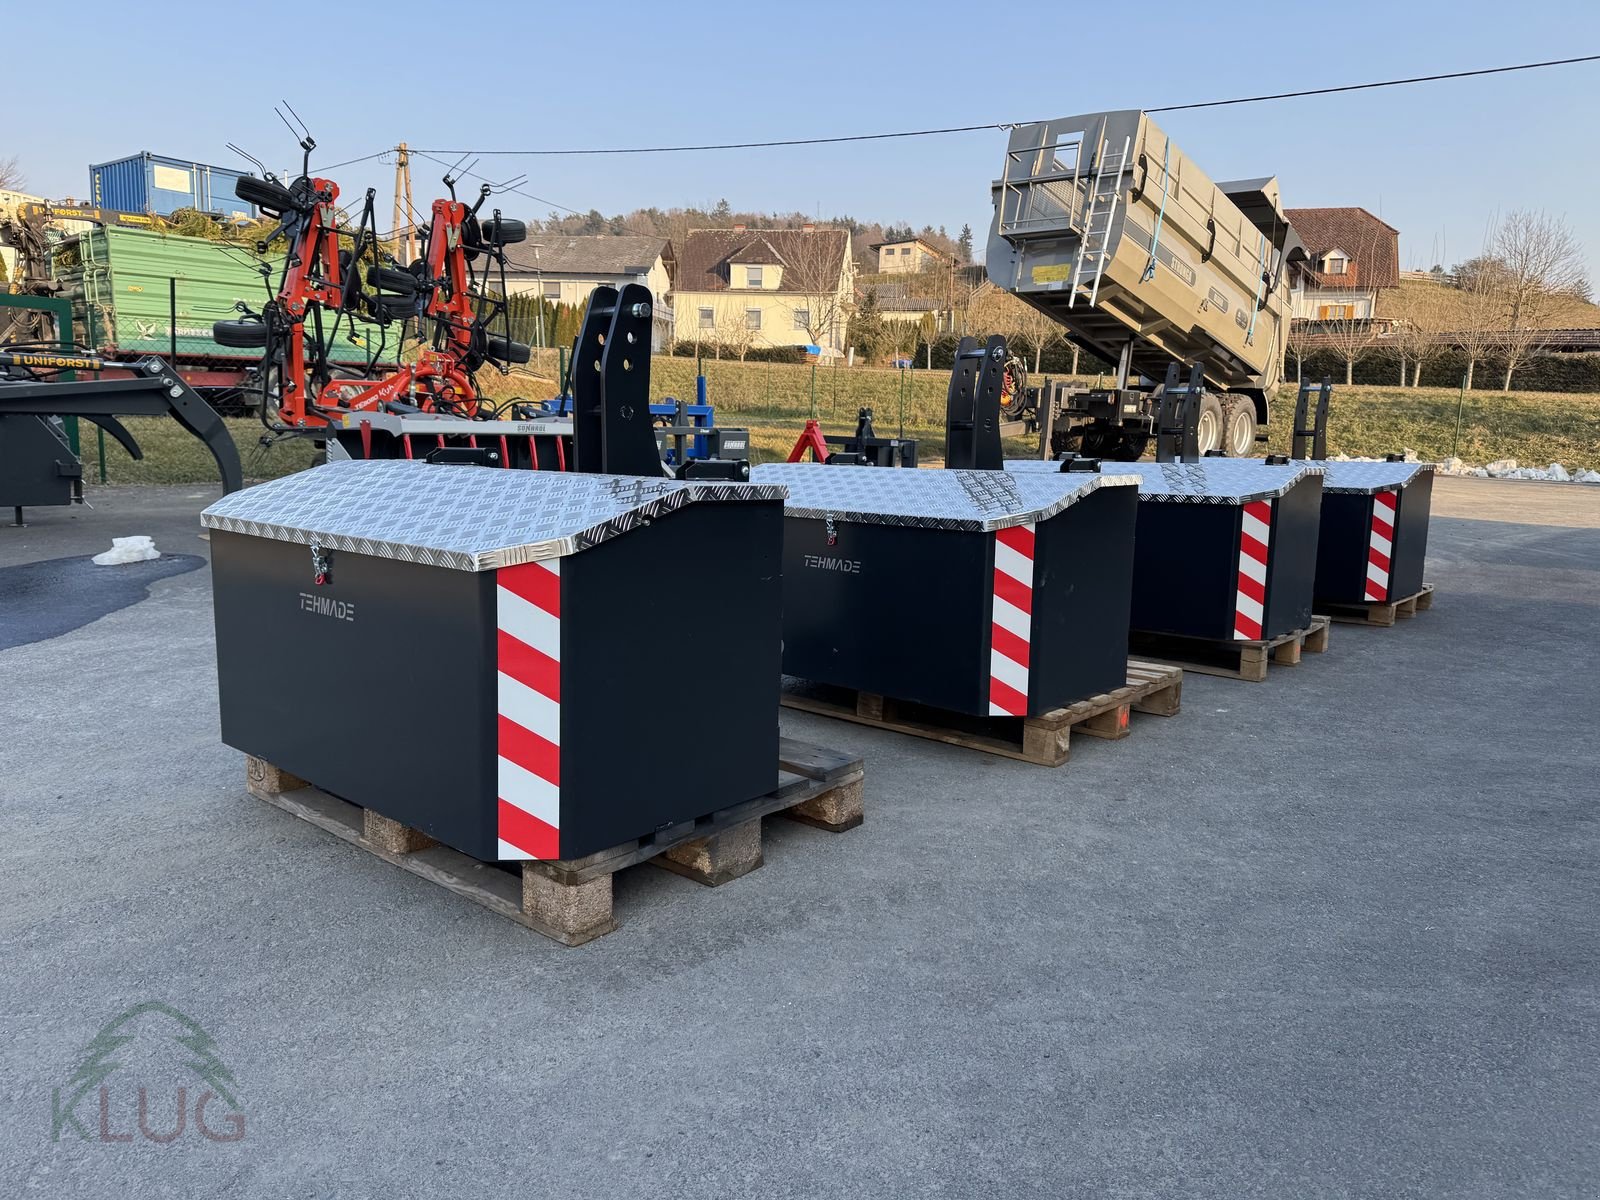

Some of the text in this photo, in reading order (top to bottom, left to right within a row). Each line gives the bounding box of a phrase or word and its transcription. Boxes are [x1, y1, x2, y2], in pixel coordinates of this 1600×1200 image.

[23, 355, 91, 368] UNIFORST
[804, 554, 862, 574] TEHMADE
[299, 592, 355, 622] TEHMADE
